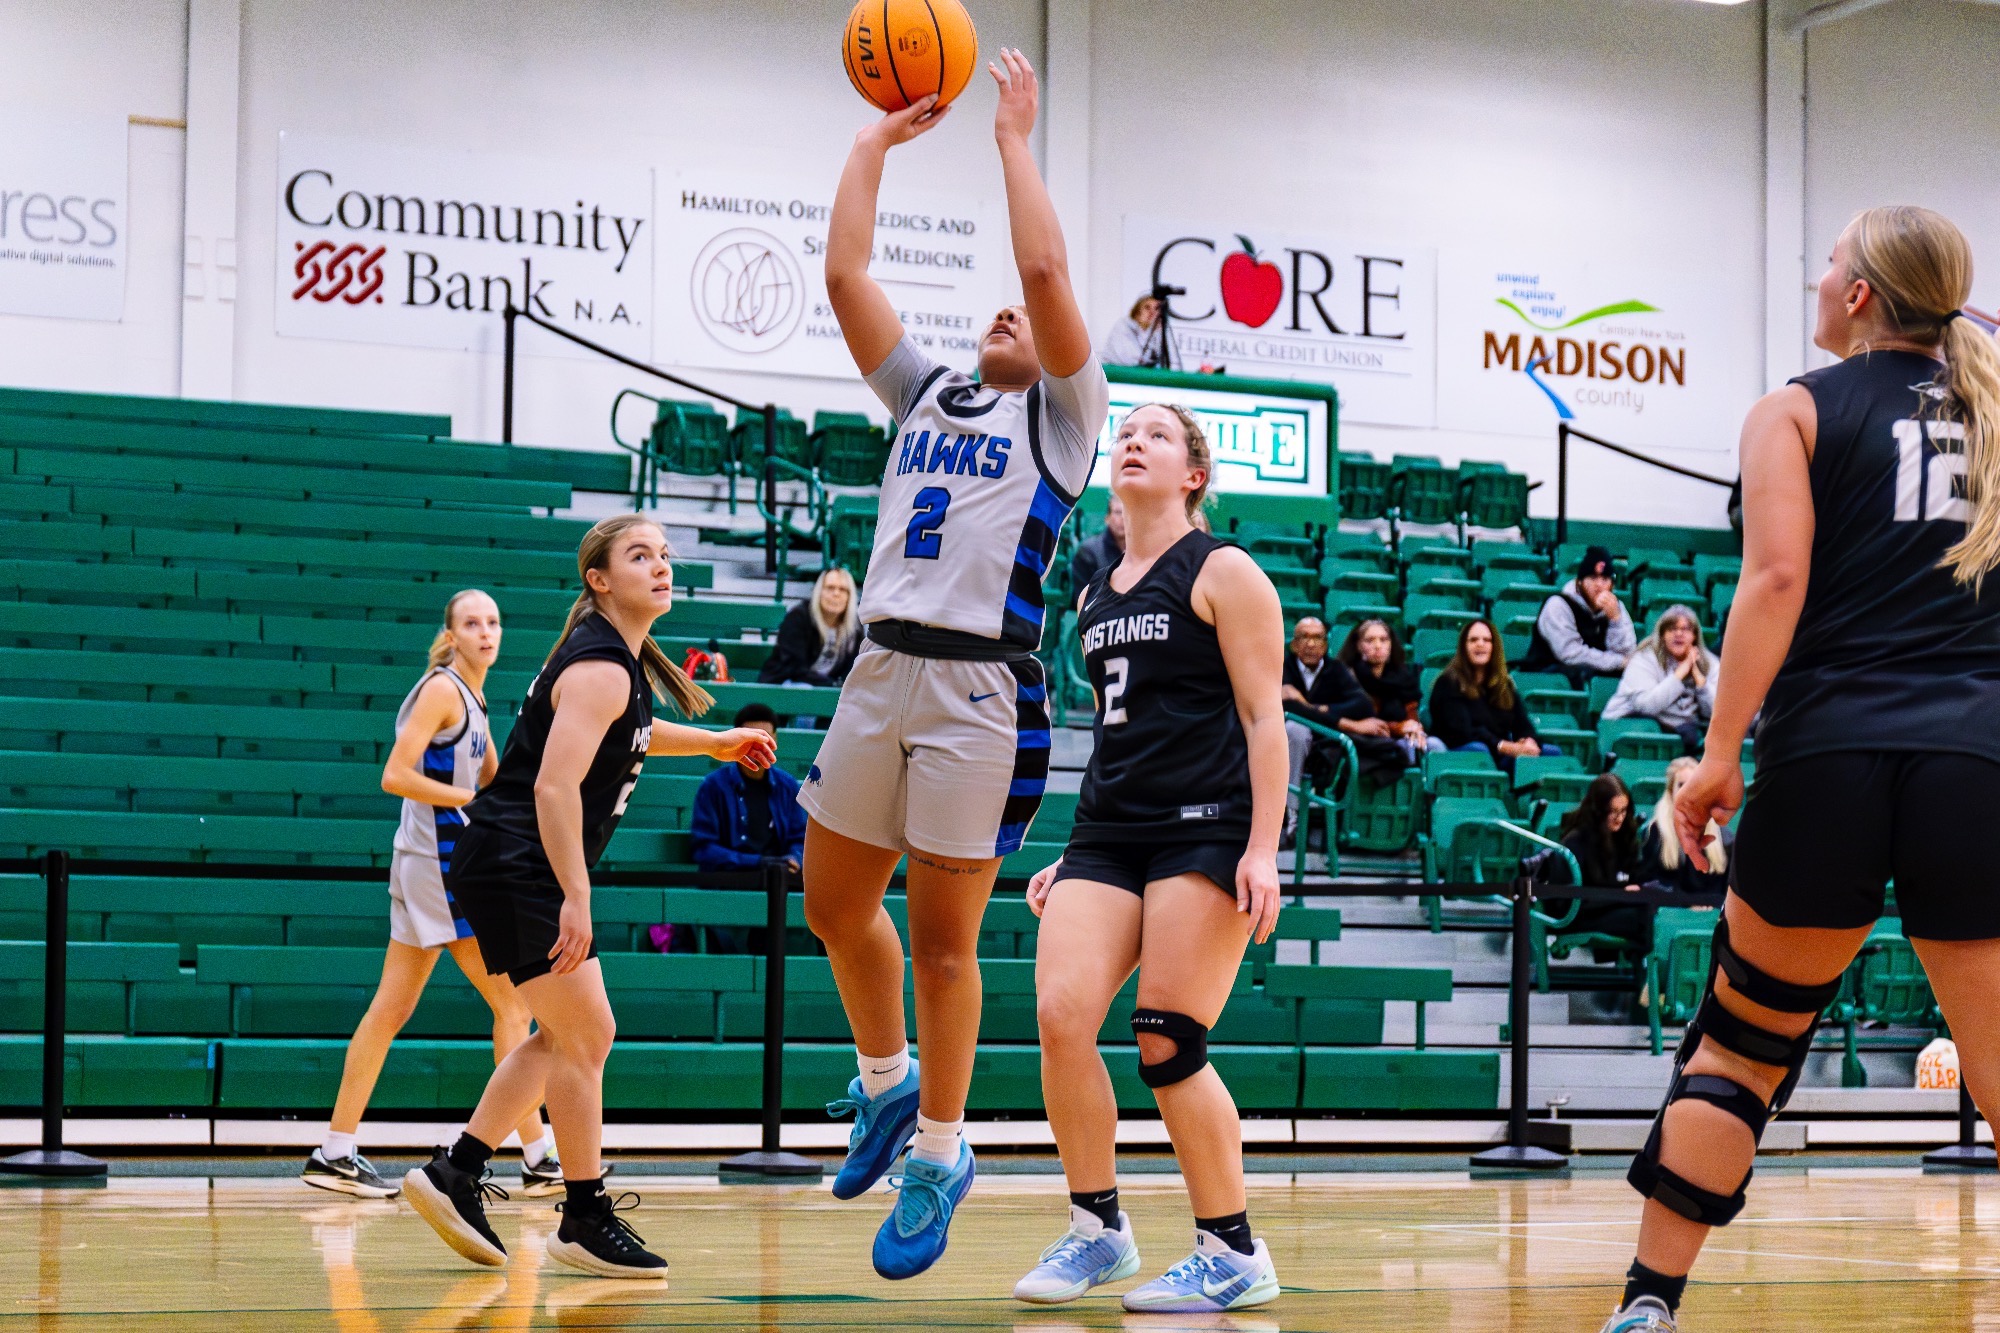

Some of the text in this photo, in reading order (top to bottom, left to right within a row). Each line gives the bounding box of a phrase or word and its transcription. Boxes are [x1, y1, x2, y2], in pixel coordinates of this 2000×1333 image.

[284, 168, 645, 274] Community
[681, 190, 976, 236] HAMILTON ORTEDICS AND
[883, 244, 976, 271] MEDICINE
[401, 250, 556, 318] Bank
[914, 311, 974, 330] STREET
[1253, 339, 1317, 364] CREDIT
[1322, 347, 1385, 368] UNION
[1482, 330, 1687, 386] MADISON
[1574, 387, 1645, 413] county
[896, 430, 1013, 480] HAWKS
[904, 486, 952, 561] 2
[1103, 656, 1130, 726] 2
